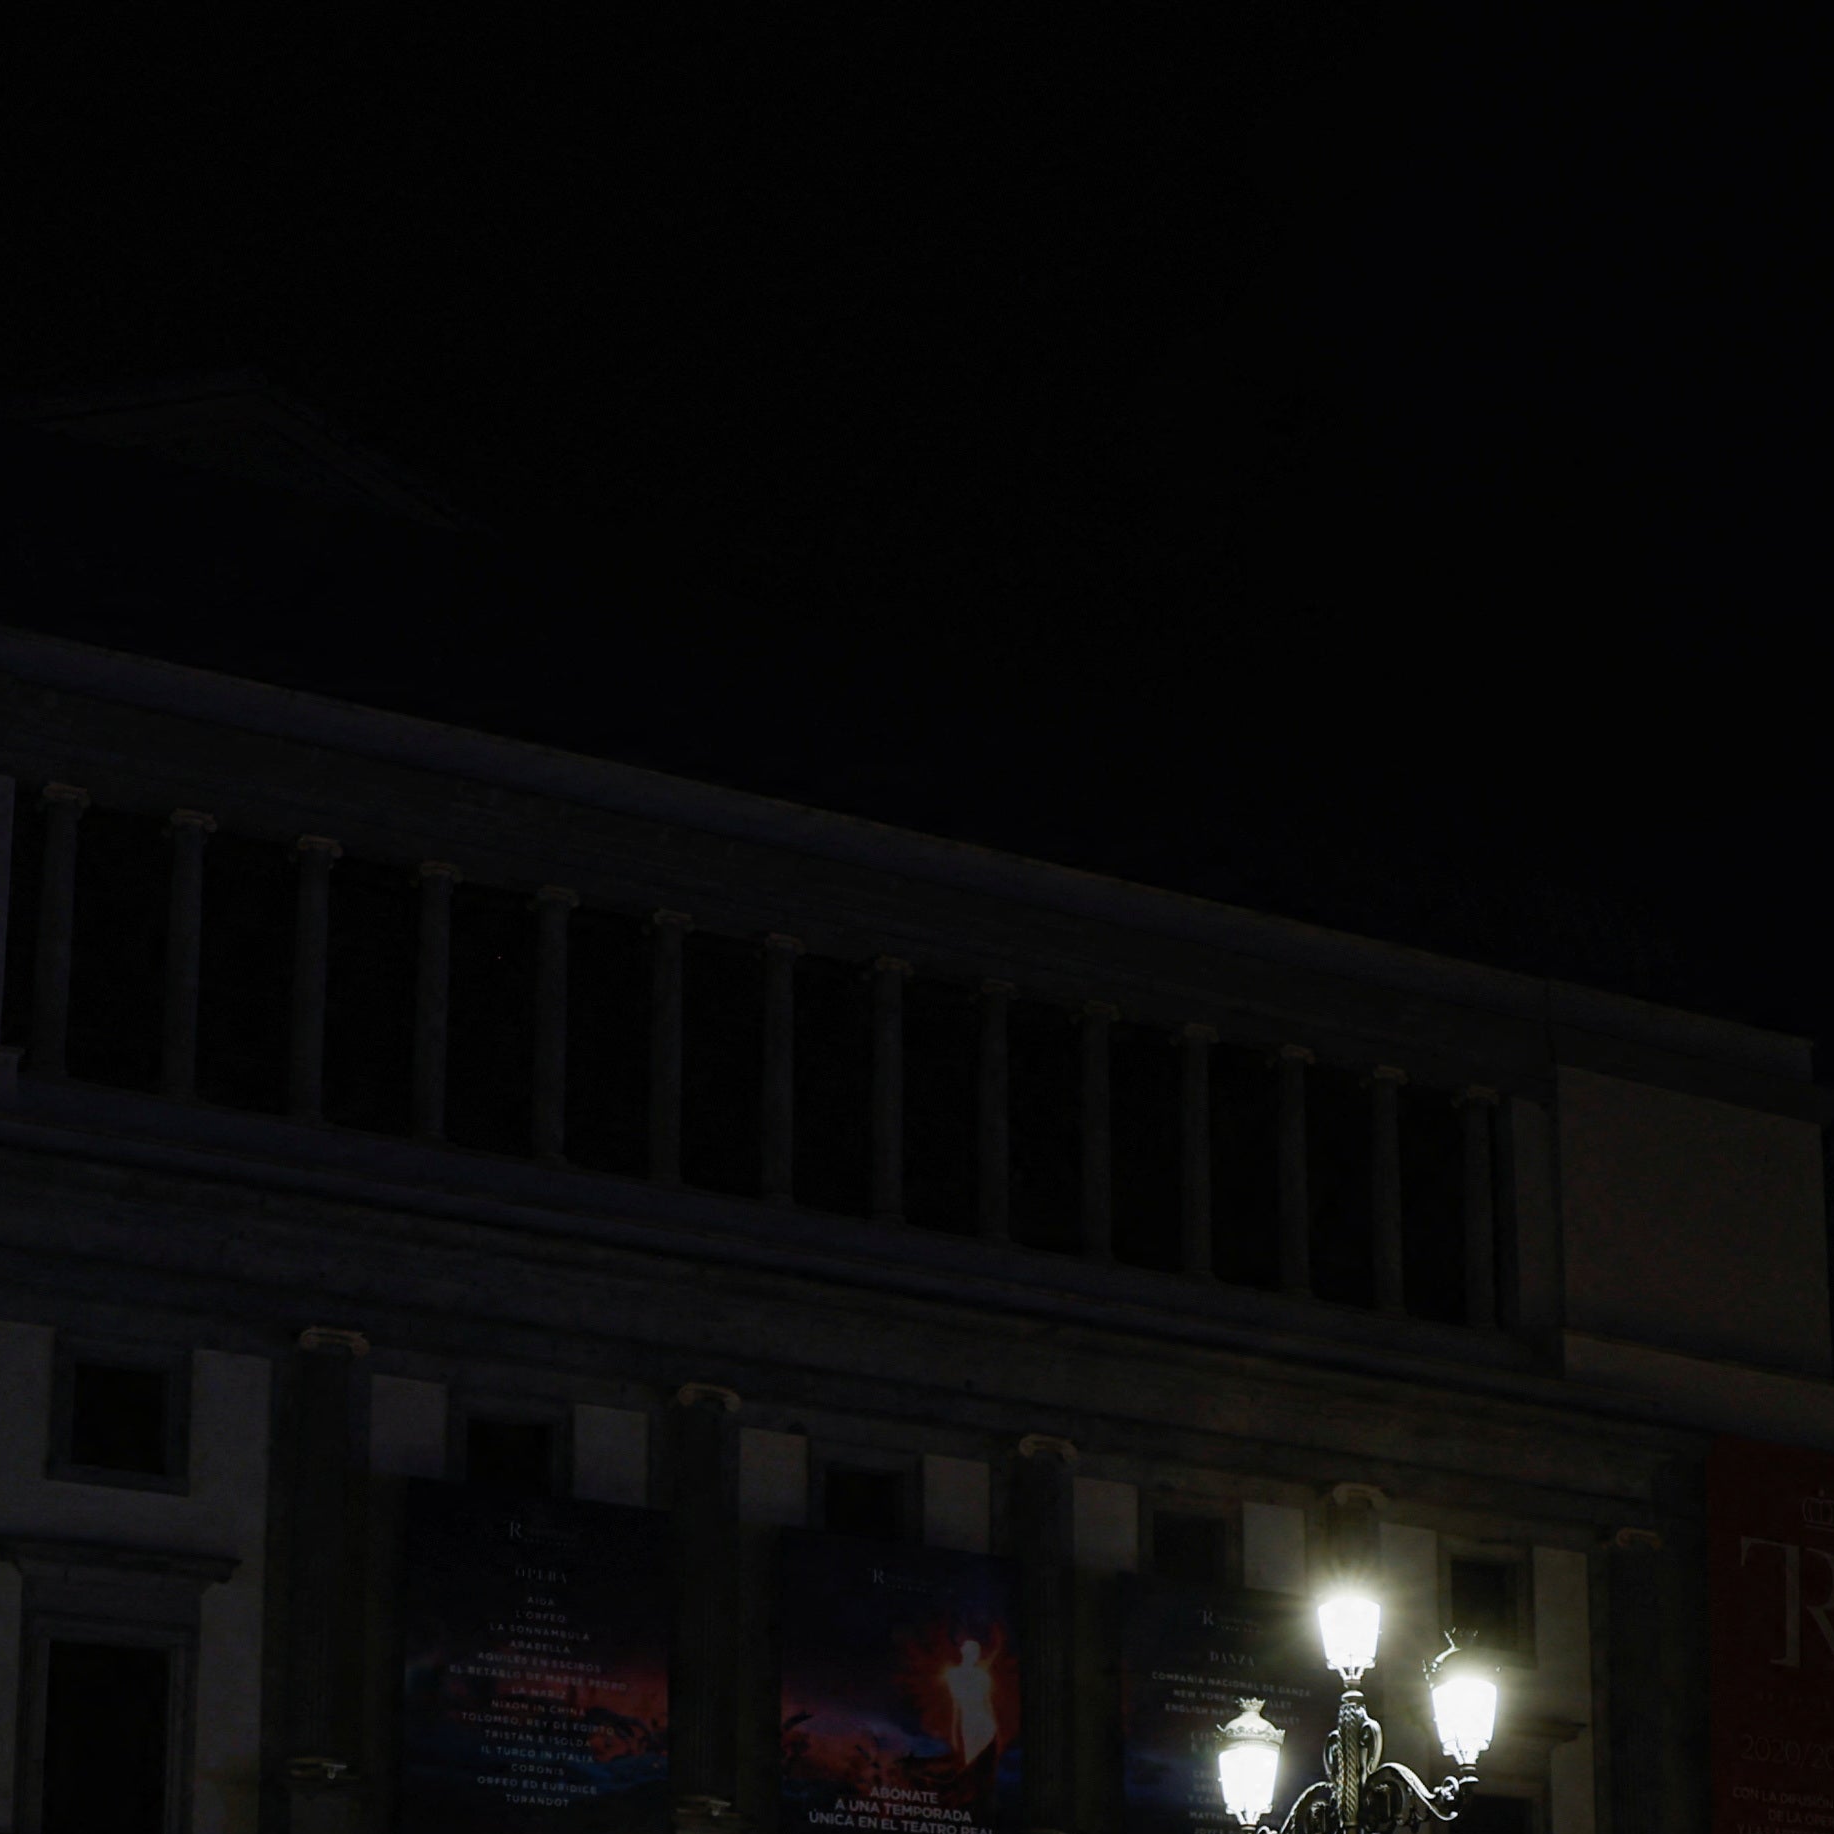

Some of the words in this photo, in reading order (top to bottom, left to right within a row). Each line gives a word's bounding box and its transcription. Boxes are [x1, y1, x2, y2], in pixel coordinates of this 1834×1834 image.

[515, 1610, 567, 1624] L'ORFEO
[489, 1622, 504, 1631] LA
[510, 1624, 590, 1641] SONNAMBULA
[509, 1640, 571, 1654] ARABELLA
[477, 1652, 528, 1666] AQUILES
[532, 1657, 548, 1667] EN
[1209, 1651, 1255, 1667] DANZA
[449, 1665, 463, 1674] EL
[467, 1666, 521, 1680] RETABLO
[526, 1671, 541, 1681] DE
[545, 1673, 584, 1687] MAESE
[588, 1678, 627, 1690] PEDRO
[511, 1686, 526, 1695] LA
[1173, 1689, 1196, 1698] NEW
[1200, 1692, 1226, 1701] YORK
[1208, 1678, 1259, 1692] NACIONAL
[1278, 1687, 1311, 1697] DANZA
[491, 1699, 529, 1711] NIXON
[533, 1704, 545, 1713] IN
[549, 1705, 586, 1717] CHINA
[1165, 1703, 1208, 1714] ENGLISH
[526, 1718, 548, 1729] REY
[553, 1722, 568, 1731] DE
[572, 1723, 615, 1736] EGIPTO
[537, 1735, 544, 1744] E
[548, 1735, 591, 1748] ISOLDA
[480, 1744, 491, 1755] IL
[496, 1746, 536, 1759] TURCO
[540, 1750, 553, 1760] IN
[555, 1752, 594, 1764] ITALIA
[510, 1763, 565, 1777] CORONIS
[476, 1775, 518, 1787] ORFEO
[522, 1779, 538, 1790] ED
[541, 1781, 598, 1796] EURIDICE
[505, 1793, 570, 1808] TURANDOT
[1732, 1786, 1759, 1799] CON
[1762, 1790, 1776, 1802] LA
[834, 1798, 845, 1811] A
[849, 1801, 880, 1813] UNA
[883, 1803, 972, 1823] TEMPORADA
[1768, 1809, 1783, 1822] DE
[1786, 1811, 1802, 1824] LA
[809, 1808, 854, 1827] ÚNICA
[858, 1818, 877, 1829] EN
[880, 1820, 897, 1831] EL
